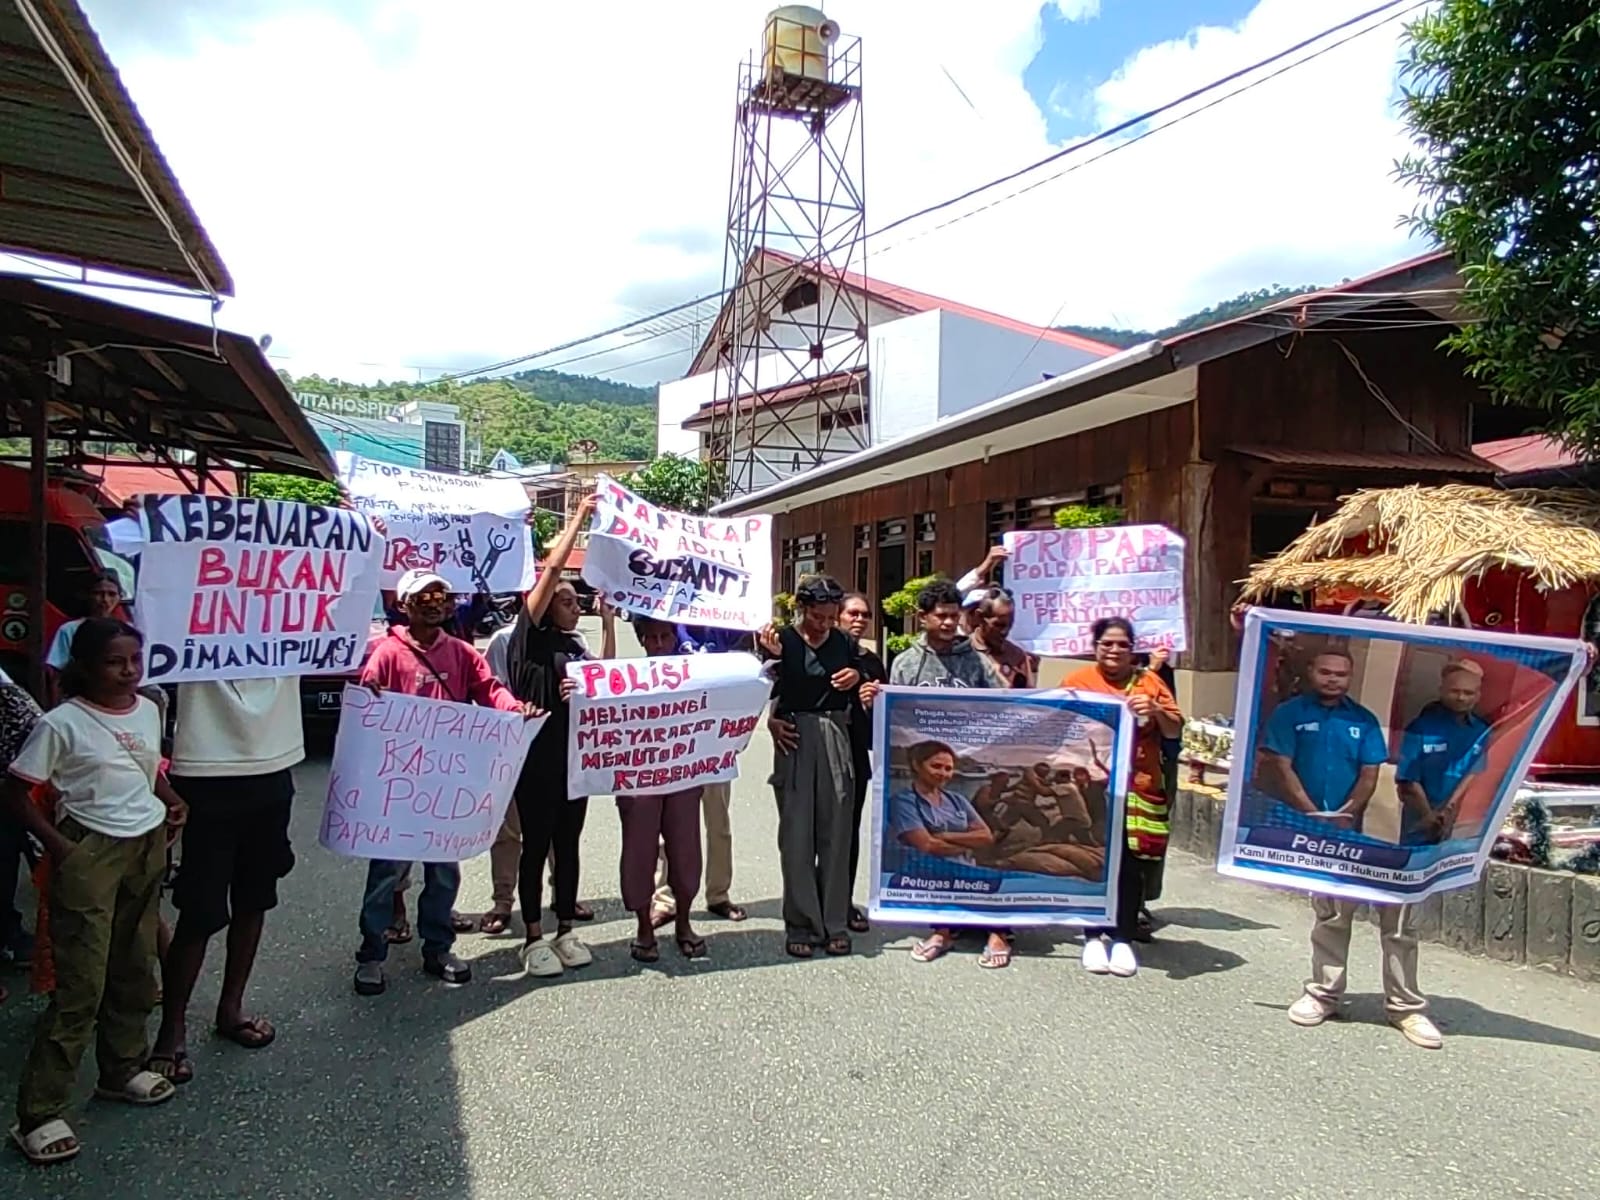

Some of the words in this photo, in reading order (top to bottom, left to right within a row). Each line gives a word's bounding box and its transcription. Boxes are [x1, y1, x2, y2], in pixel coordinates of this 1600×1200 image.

[356, 461, 402, 478] STOP
[145, 494, 371, 552] KEBENARAN
[608, 484, 762, 542] TANGKAP
[607, 515, 659, 551] DAN
[1013, 529, 1169, 563] PROPAM
[197, 547, 346, 592] BUKAN
[1095, 556, 1167, 576] PAPUA
[632, 577, 707, 603] RAJAK
[1021, 591, 1110, 609] PERIKSA
[189, 589, 342, 635] UNTUK
[322, 694, 334, 704] PA
[577, 717, 716, 750] MASYARAKAT
[377, 738, 467, 777] KASUS
[1238, 846, 1264, 859] Kami
[1267, 851, 1295, 863] Minta
[1297, 855, 1333, 870] Pelaku
[1338, 861, 1349, 872] di
[1351, 863, 1390, 880] Hukum
[1292, 833, 1364, 861] Pelaku
[901, 876, 950, 890] Petugas
[953, 877, 991, 891] Medis
